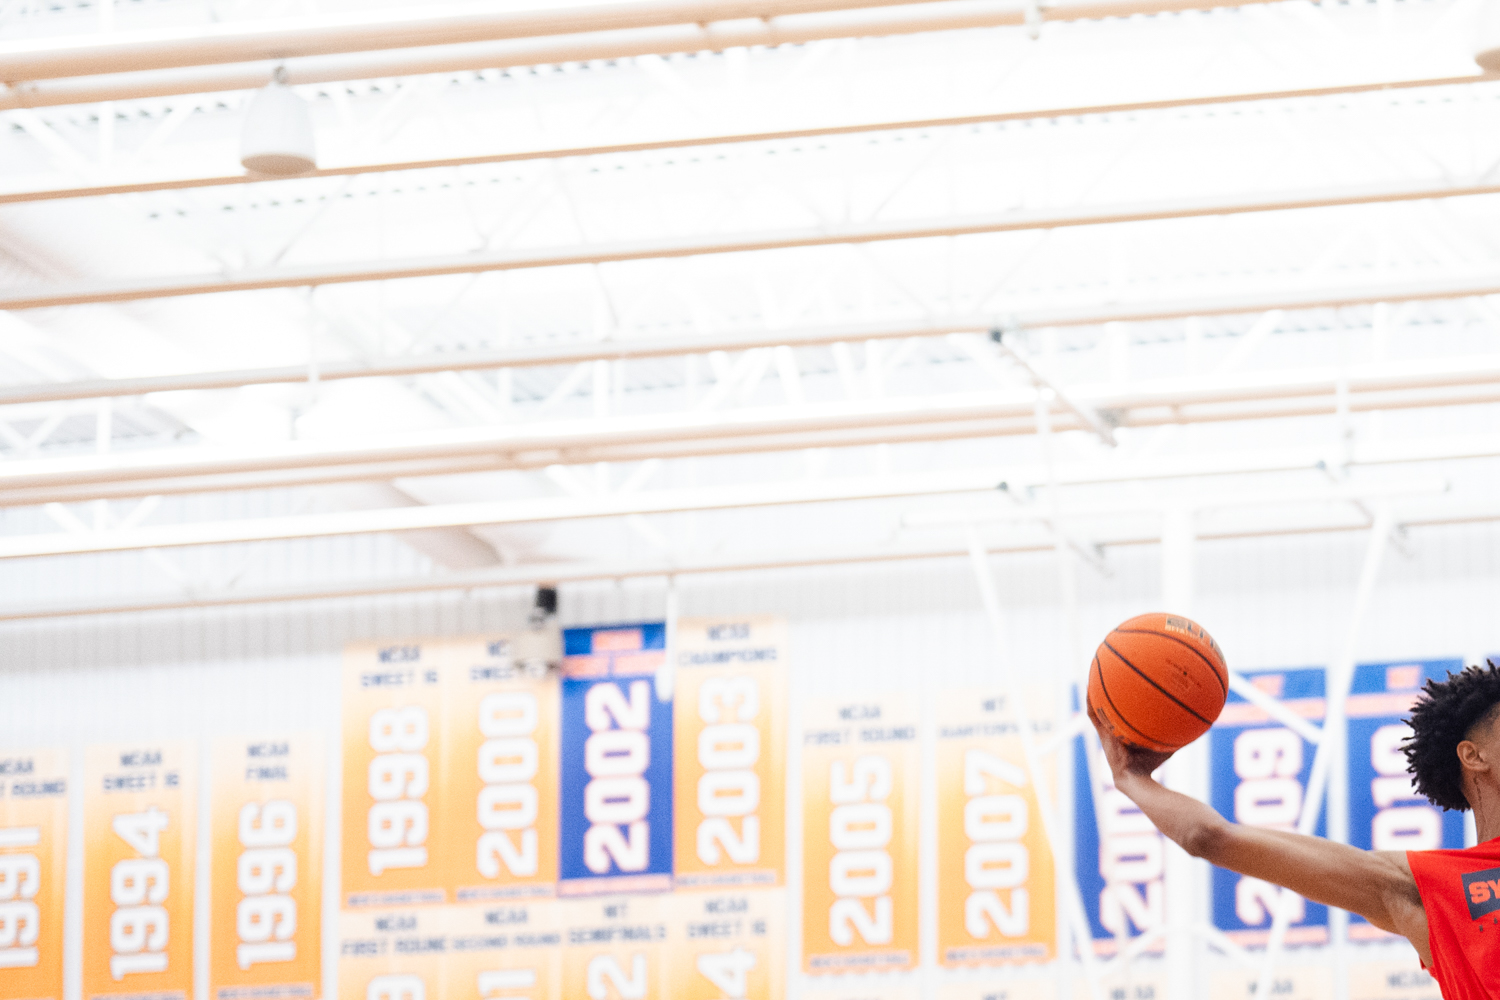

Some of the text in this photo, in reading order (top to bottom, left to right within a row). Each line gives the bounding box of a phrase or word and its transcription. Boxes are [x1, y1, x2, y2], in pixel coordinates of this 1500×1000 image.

[368, 706, 429, 876] 1998
[477, 692, 538, 878] 2000
[584, 681, 650, 873] 2002
[697, 676, 759, 865] 2003
[829, 756, 893, 945] 2005
[964, 749, 1028, 938] 2007
[111, 806, 169, 981] 1994
[237, 800, 297, 970] 1996
